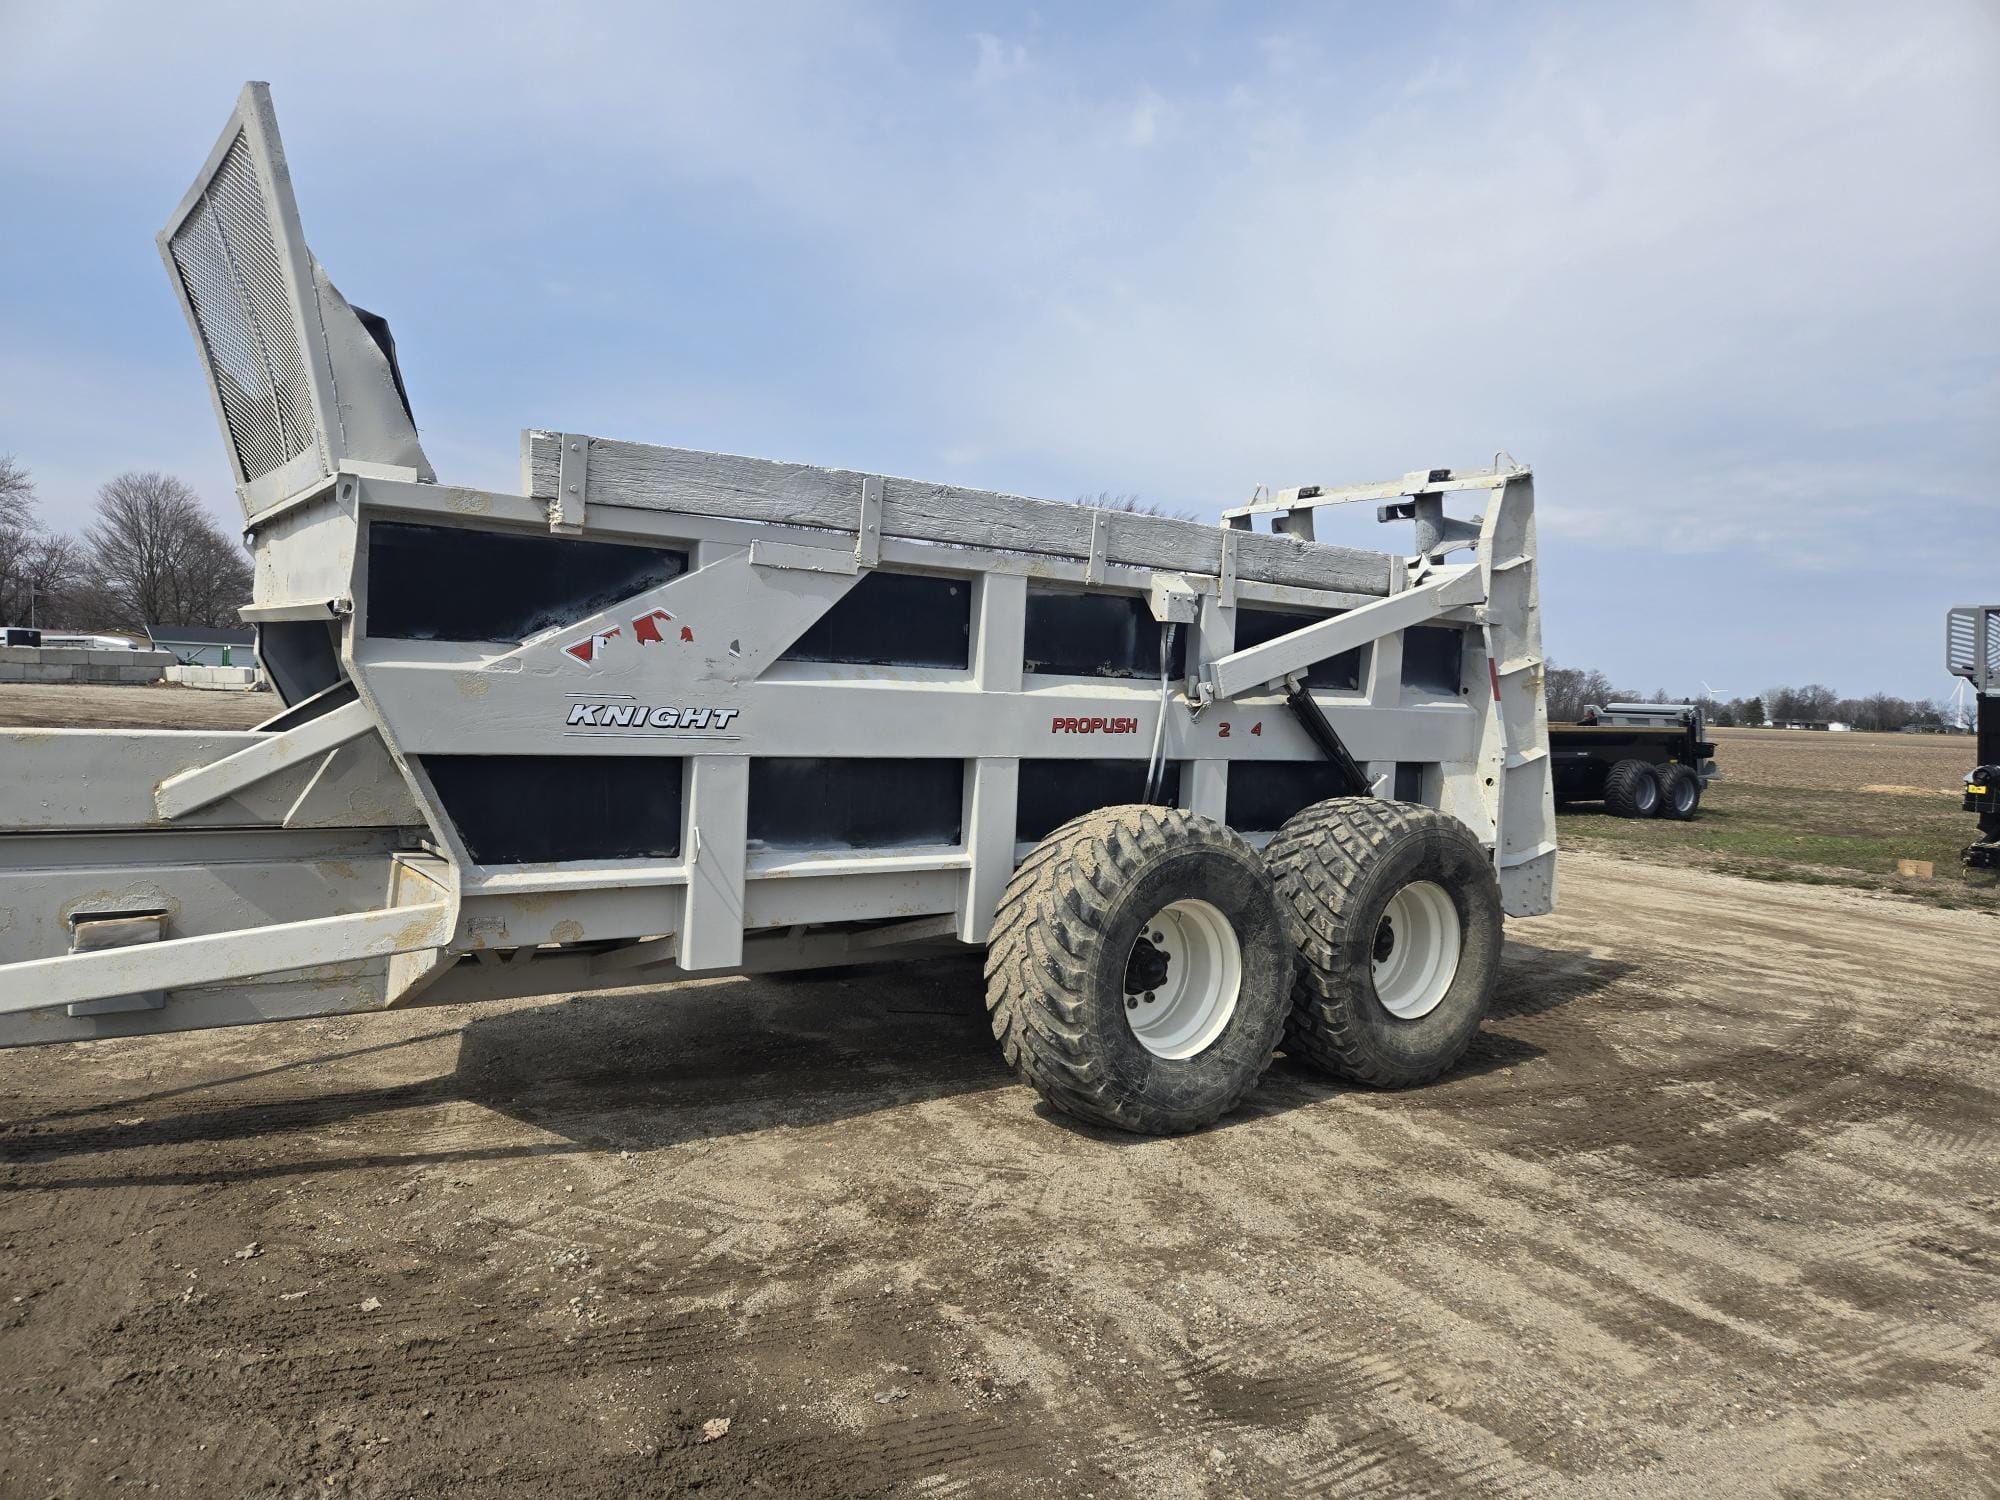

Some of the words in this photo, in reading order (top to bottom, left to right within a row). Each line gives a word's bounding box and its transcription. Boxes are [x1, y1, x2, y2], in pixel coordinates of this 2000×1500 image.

[566, 703, 739, 729] KNIGHT
[1052, 717, 1138, 734] PROPUSH
[1218, 722, 1231, 737] 2
[1250, 721, 1262, 736] 4
